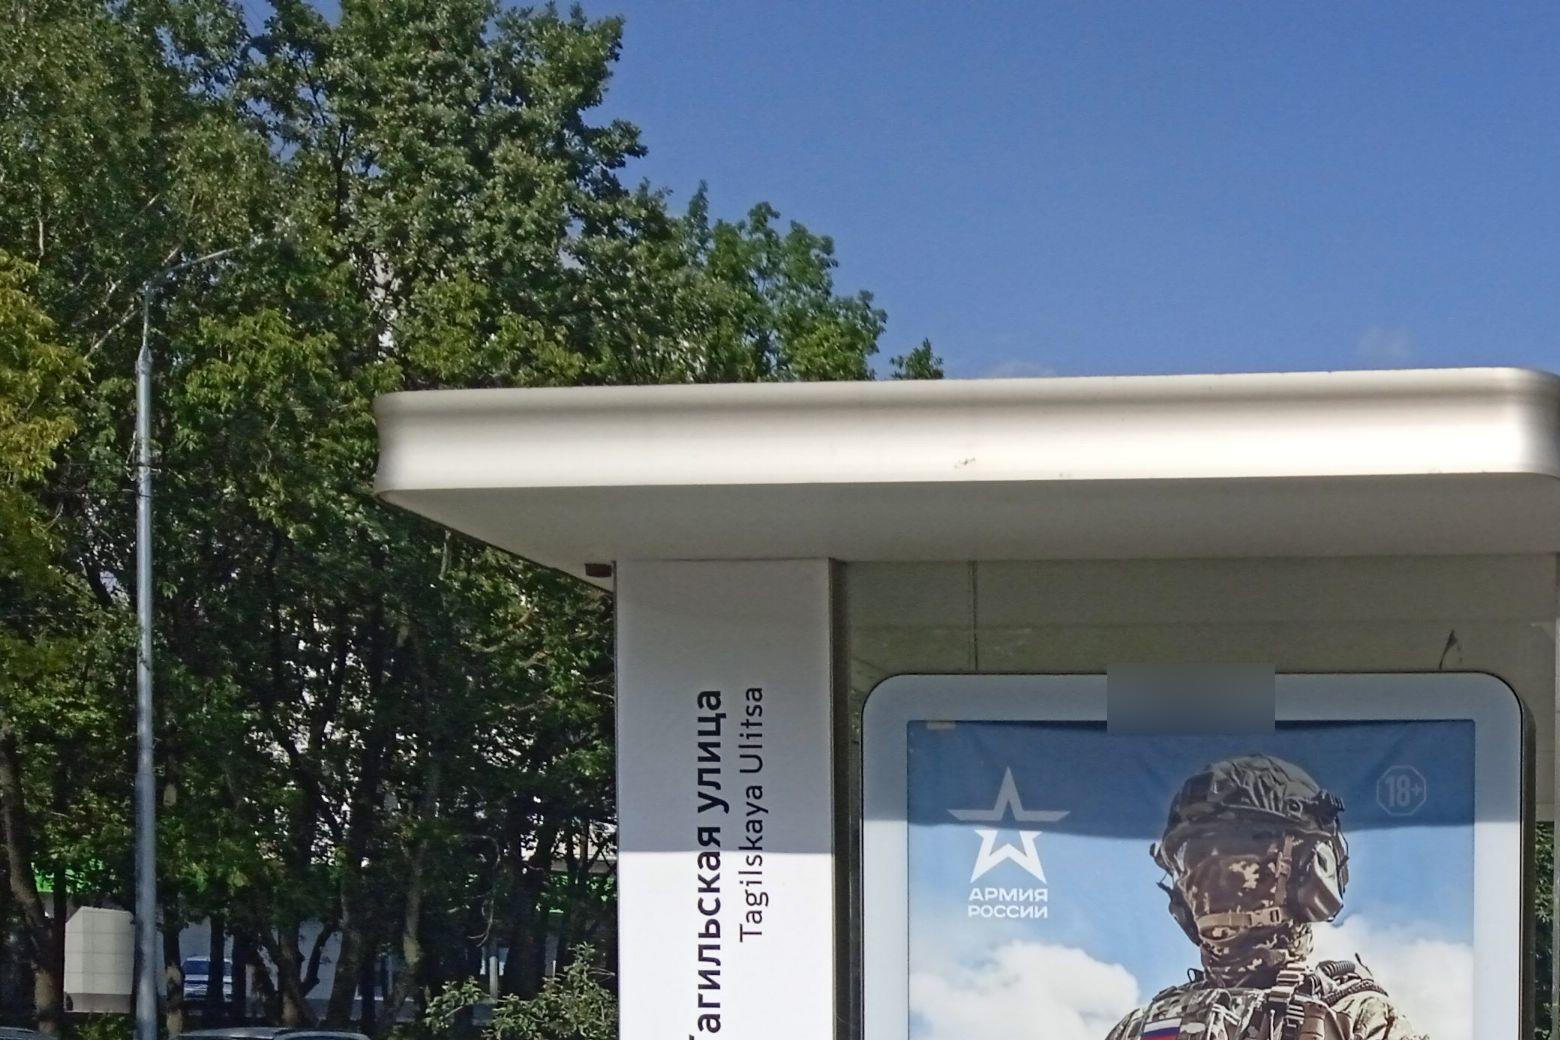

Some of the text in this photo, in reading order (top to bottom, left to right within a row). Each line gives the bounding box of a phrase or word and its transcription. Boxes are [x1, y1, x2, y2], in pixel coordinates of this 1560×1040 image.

[697, 689, 729, 815] улица
[1384, 775, 1423, 808] 18+
[739, 686, 769, 943] Tagilskaya Ulitsa
[968, 887, 1048, 902] АРМИЯ
[968, 905, 1048, 919] РОССИИ
